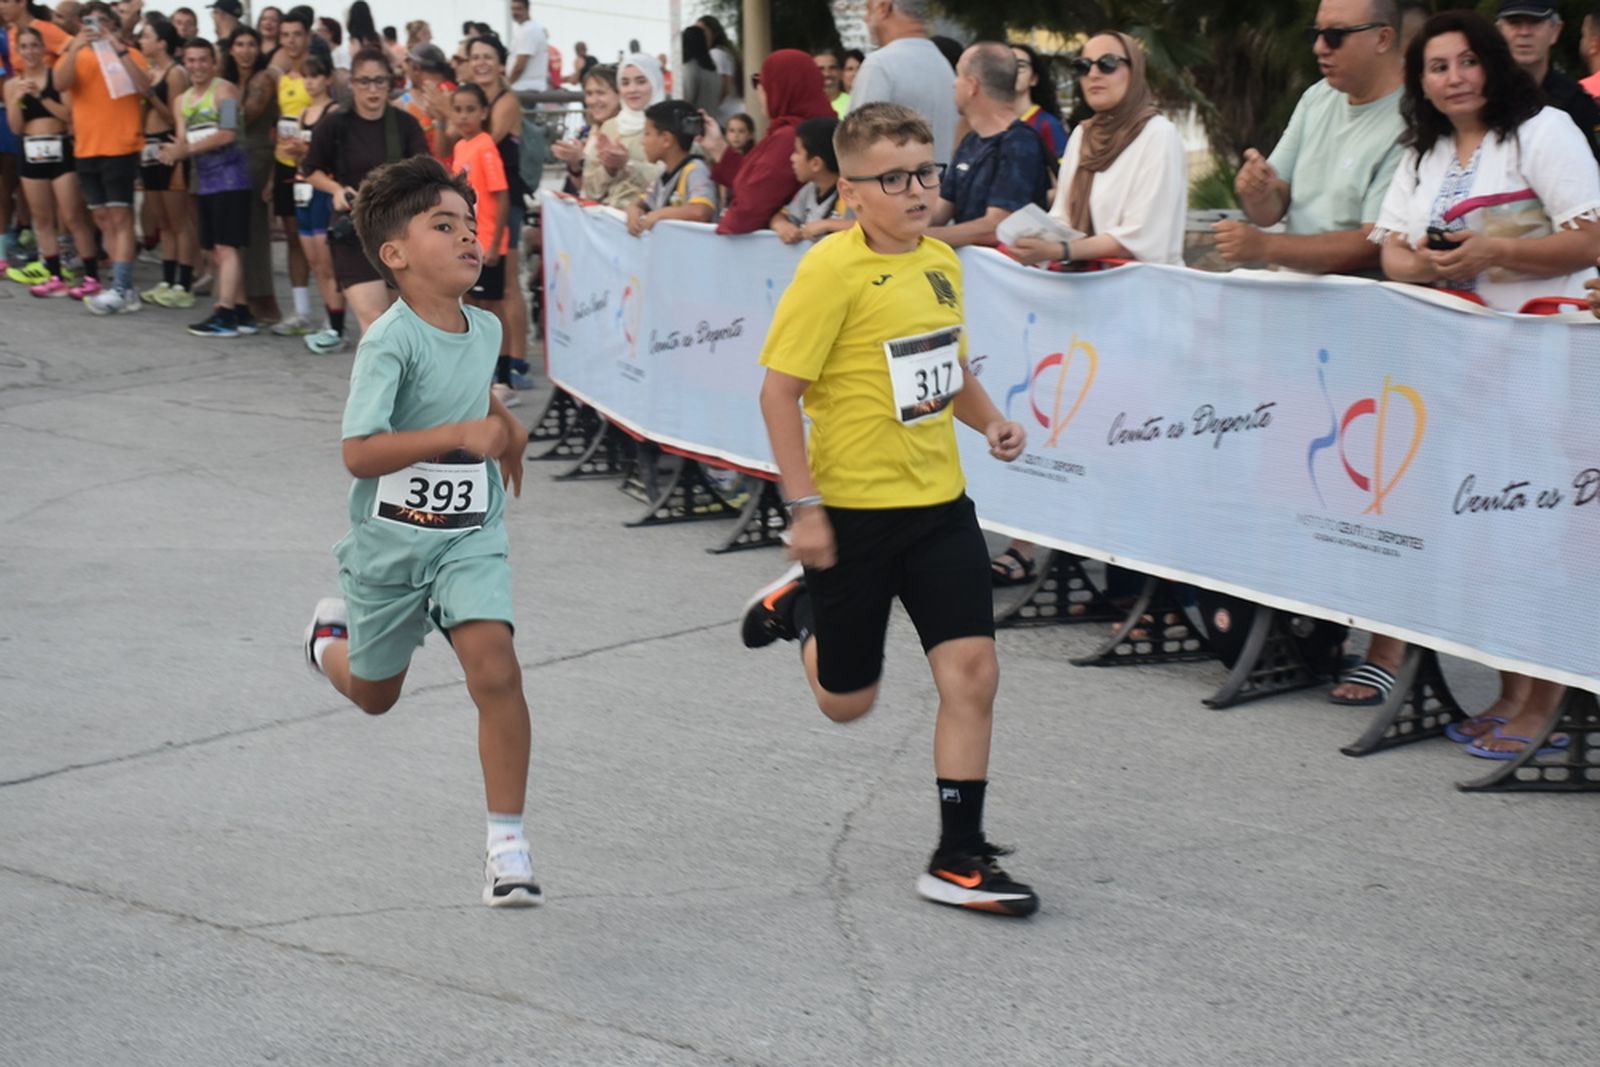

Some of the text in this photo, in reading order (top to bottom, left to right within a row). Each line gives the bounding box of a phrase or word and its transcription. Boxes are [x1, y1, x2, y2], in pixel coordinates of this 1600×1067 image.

[915, 361, 953, 401] 317
[1107, 403, 1277, 449] Ceuta es Deporte
[404, 476, 474, 513] 393
[1453, 467, 1600, 515] Ceuta es D
